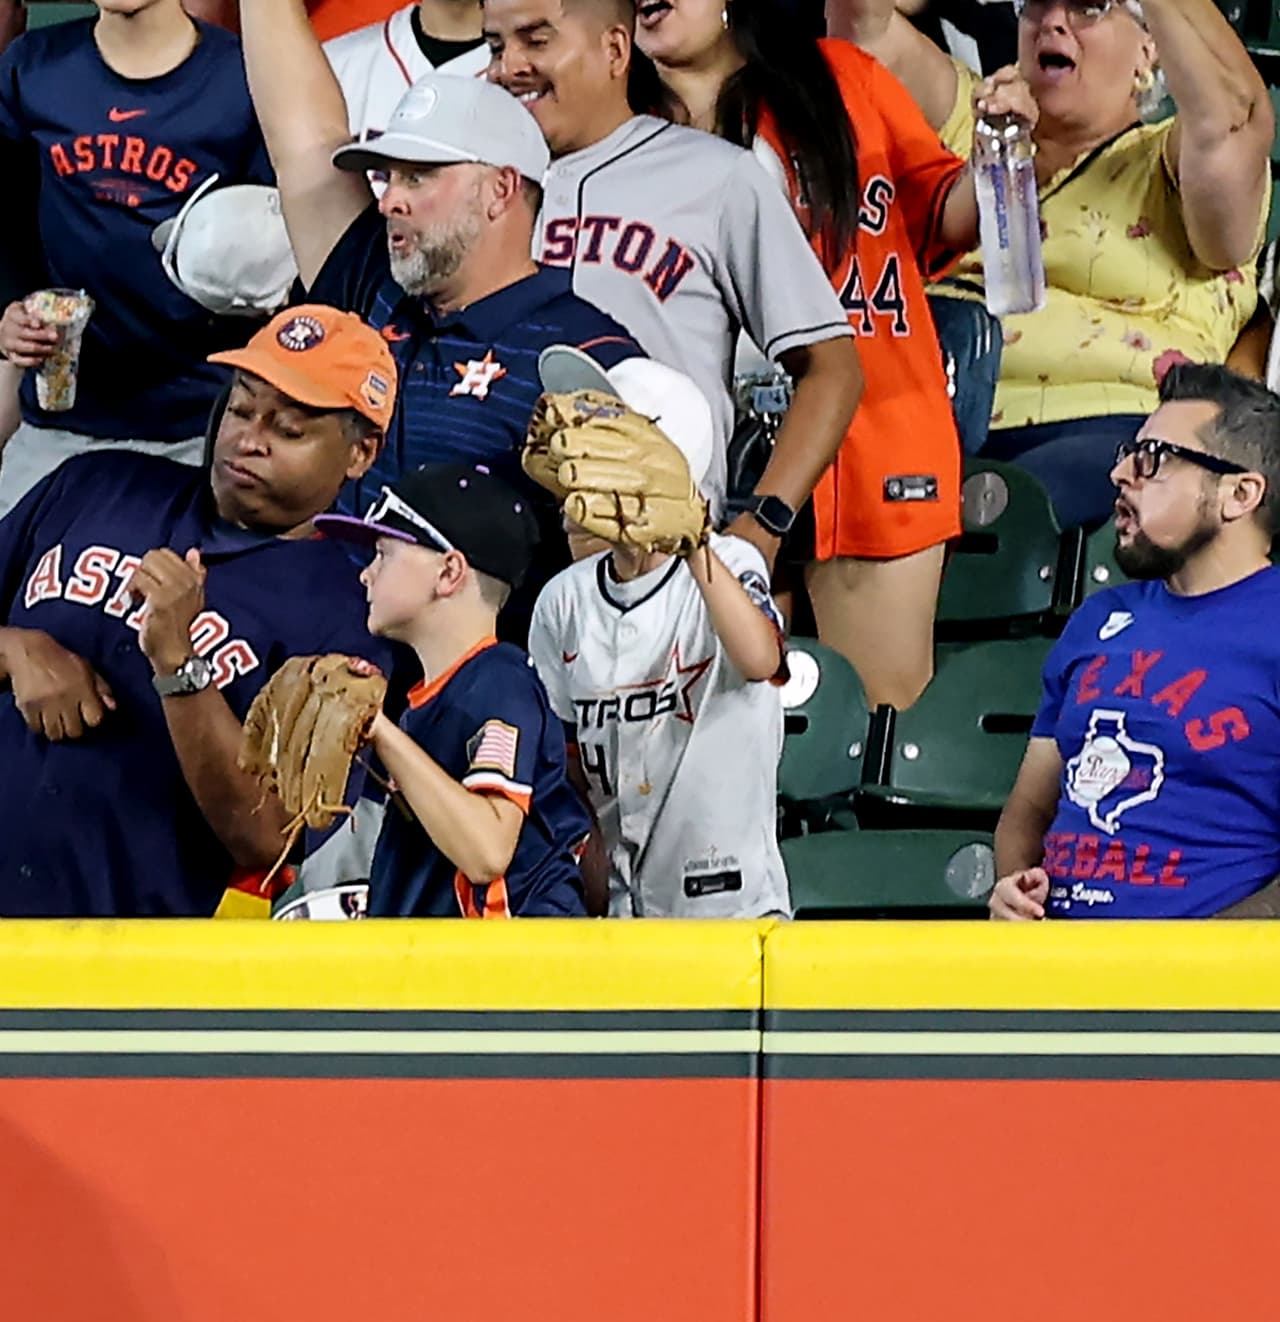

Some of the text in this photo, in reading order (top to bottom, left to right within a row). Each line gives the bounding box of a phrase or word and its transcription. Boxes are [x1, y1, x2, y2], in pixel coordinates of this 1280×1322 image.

[49, 133, 198, 193] ASTROS
[839, 253, 911, 338] 44
[1076, 648, 1253, 752] EXAS
